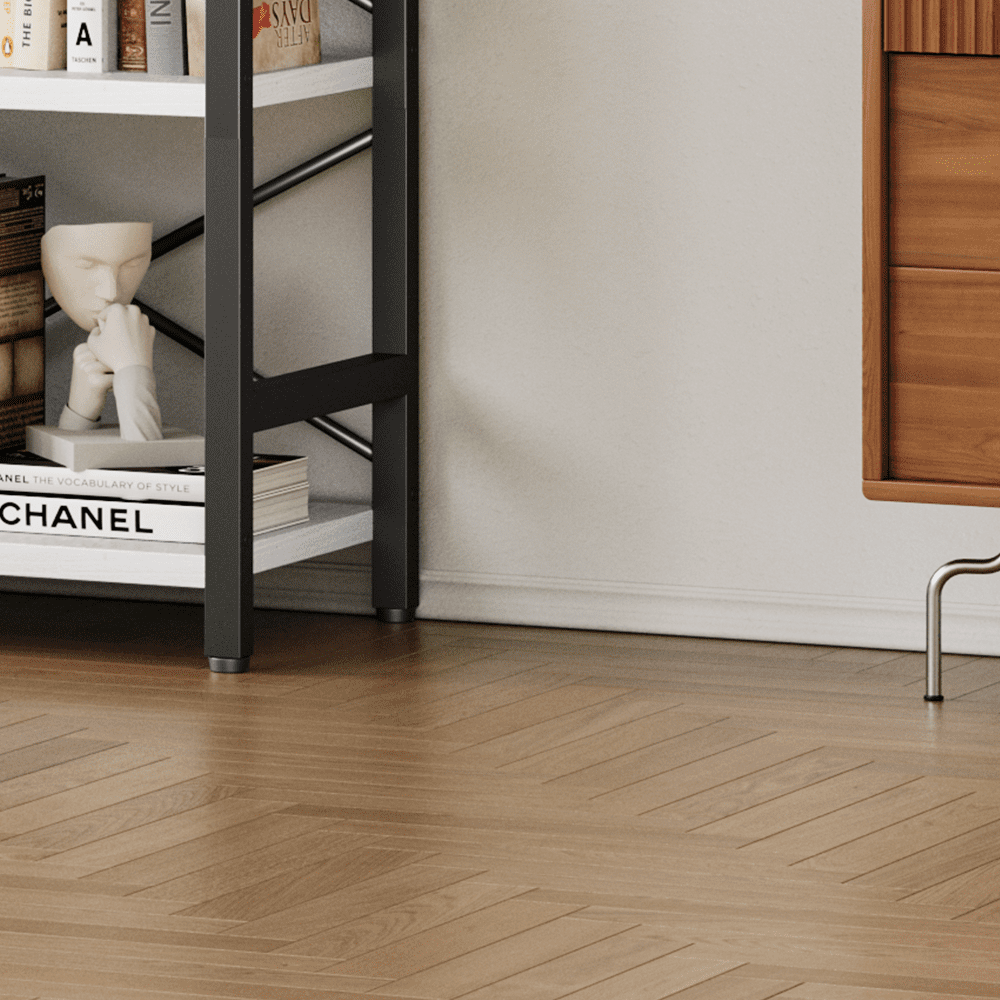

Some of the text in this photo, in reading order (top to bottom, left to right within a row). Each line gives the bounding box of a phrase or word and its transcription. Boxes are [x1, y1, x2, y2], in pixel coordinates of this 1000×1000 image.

[22, 22, 32, 48] THE
[76, 22, 92, 46] A
[274, 24, 310, 48] AFTER
[33, 476, 54, 486] THE
[58, 477, 134, 490] VOCABULARY
[136, 480, 152, 491] OF
[155, 483, 190, 494] STYLE
